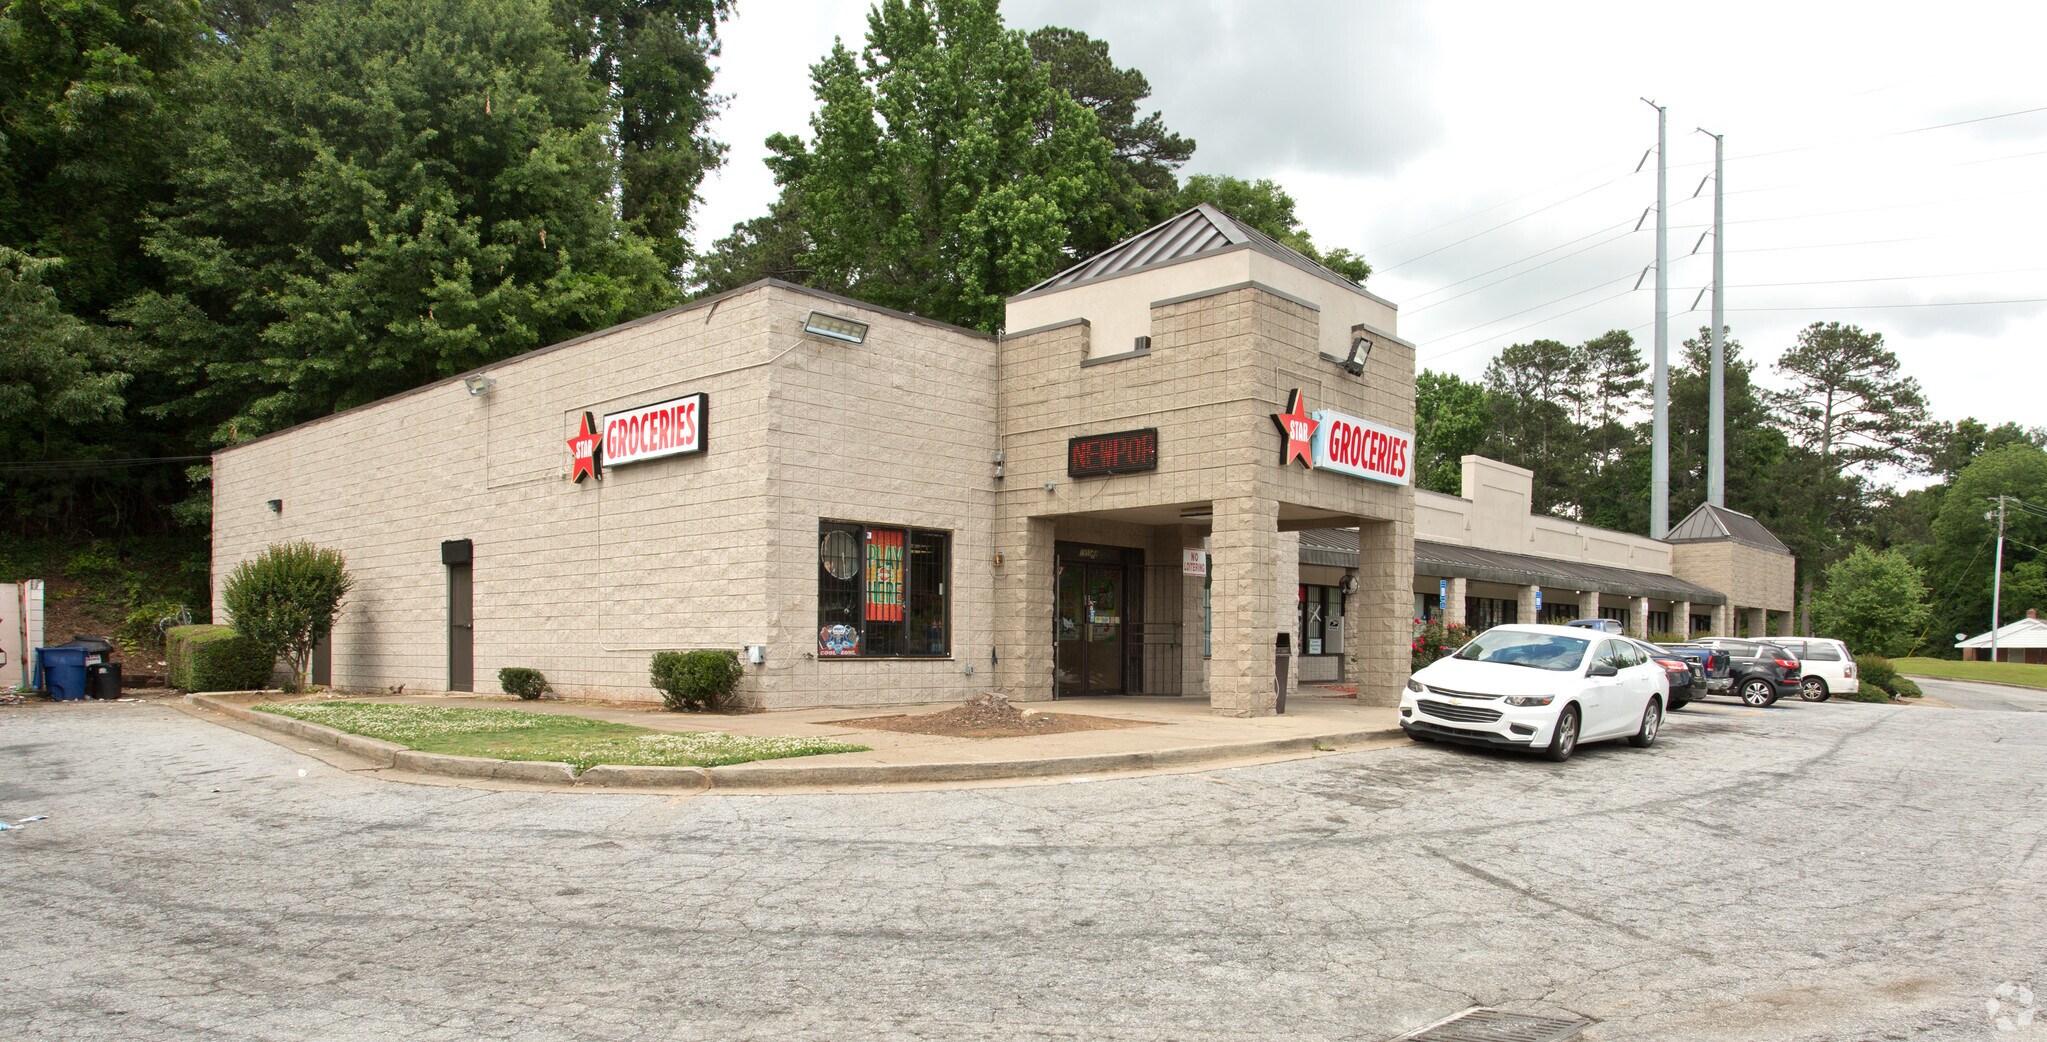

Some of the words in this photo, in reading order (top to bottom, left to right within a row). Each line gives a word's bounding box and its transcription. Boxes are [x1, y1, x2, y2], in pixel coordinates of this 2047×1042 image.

[575, 439, 593, 460] STAR
[606, 402, 696, 460] GROCERIES
[1289, 419, 1309, 443] STAR
[1329, 420, 1408, 478] GROCERIES
[866, 544, 904, 570] PLAY
[1184, 561, 1205, 572] LOITERING
[1190, 552, 1199, 562] NO
[866, 581, 903, 604] HERE
